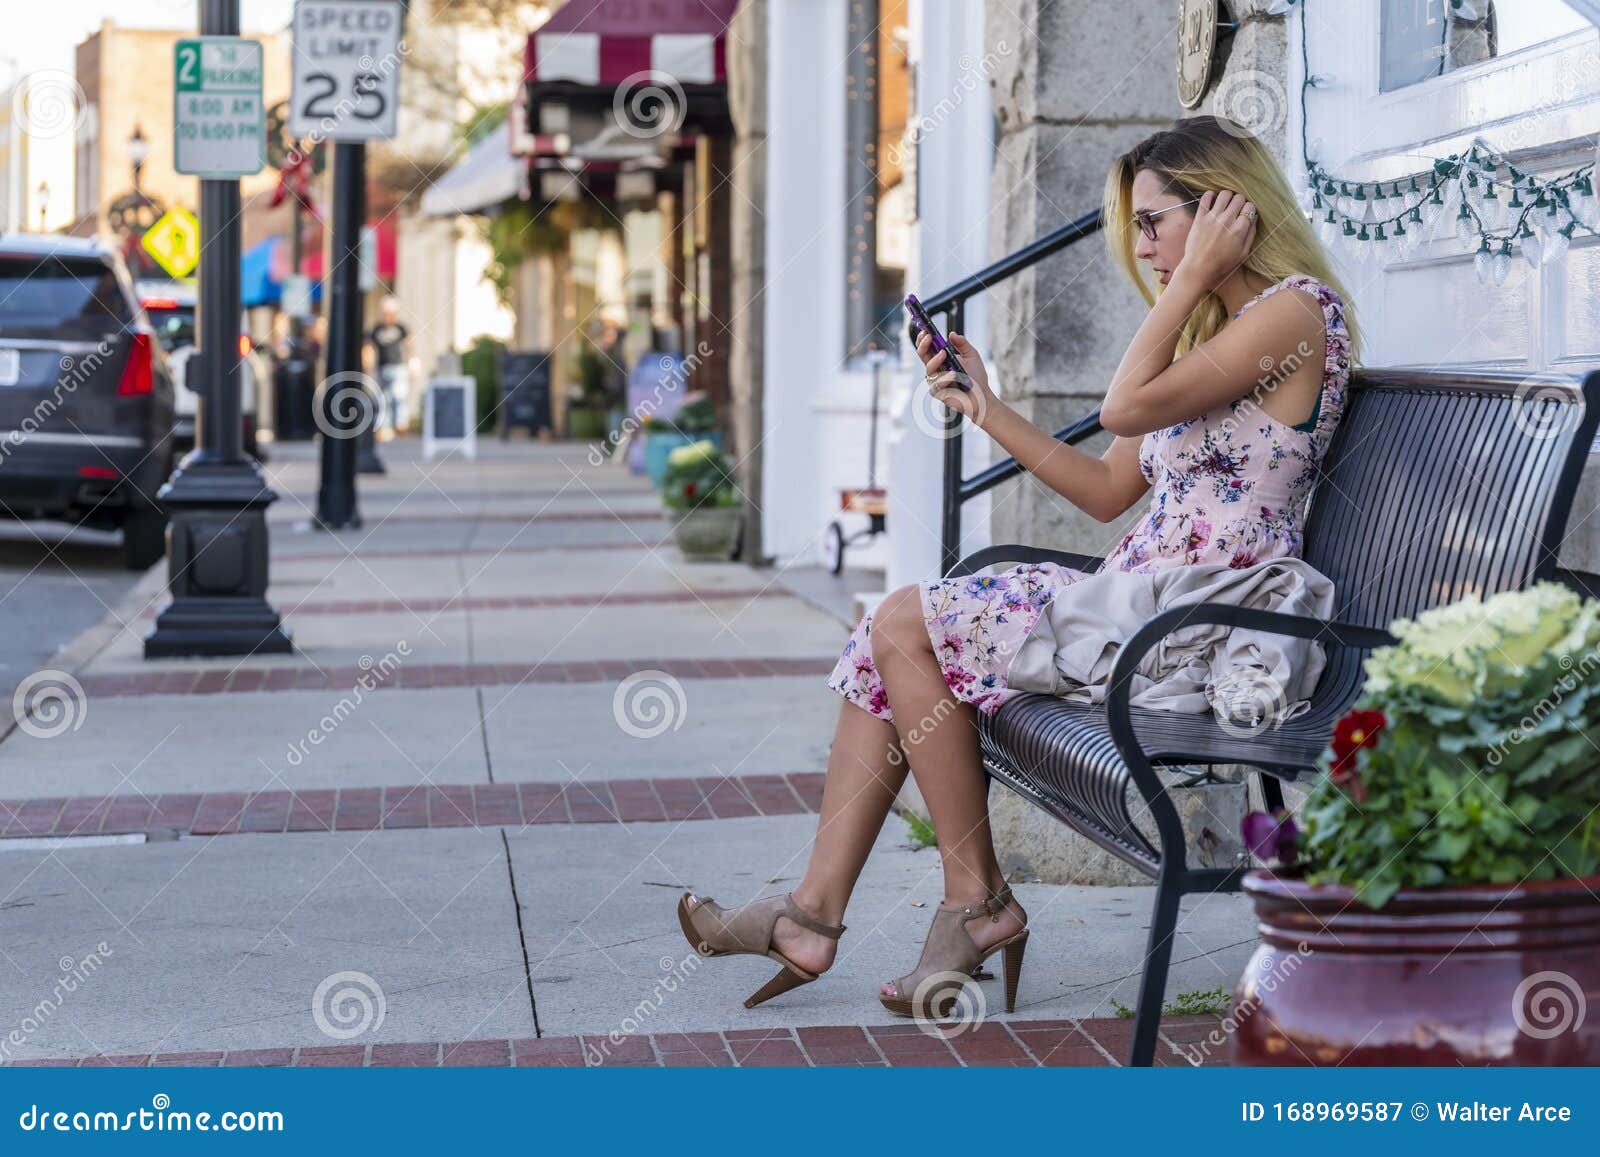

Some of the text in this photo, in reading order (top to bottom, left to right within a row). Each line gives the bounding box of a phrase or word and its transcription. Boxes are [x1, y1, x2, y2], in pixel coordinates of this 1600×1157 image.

[303, 9, 393, 30] SPEED
[310, 38, 380, 58] LIMIT
[178, 48, 197, 84] 2
[202, 67, 259, 84] PARKING
[303, 73, 387, 120] 25
[231, 99, 255, 115] AM
[181, 122, 199, 141] TO
[238, 122, 259, 140] PM
